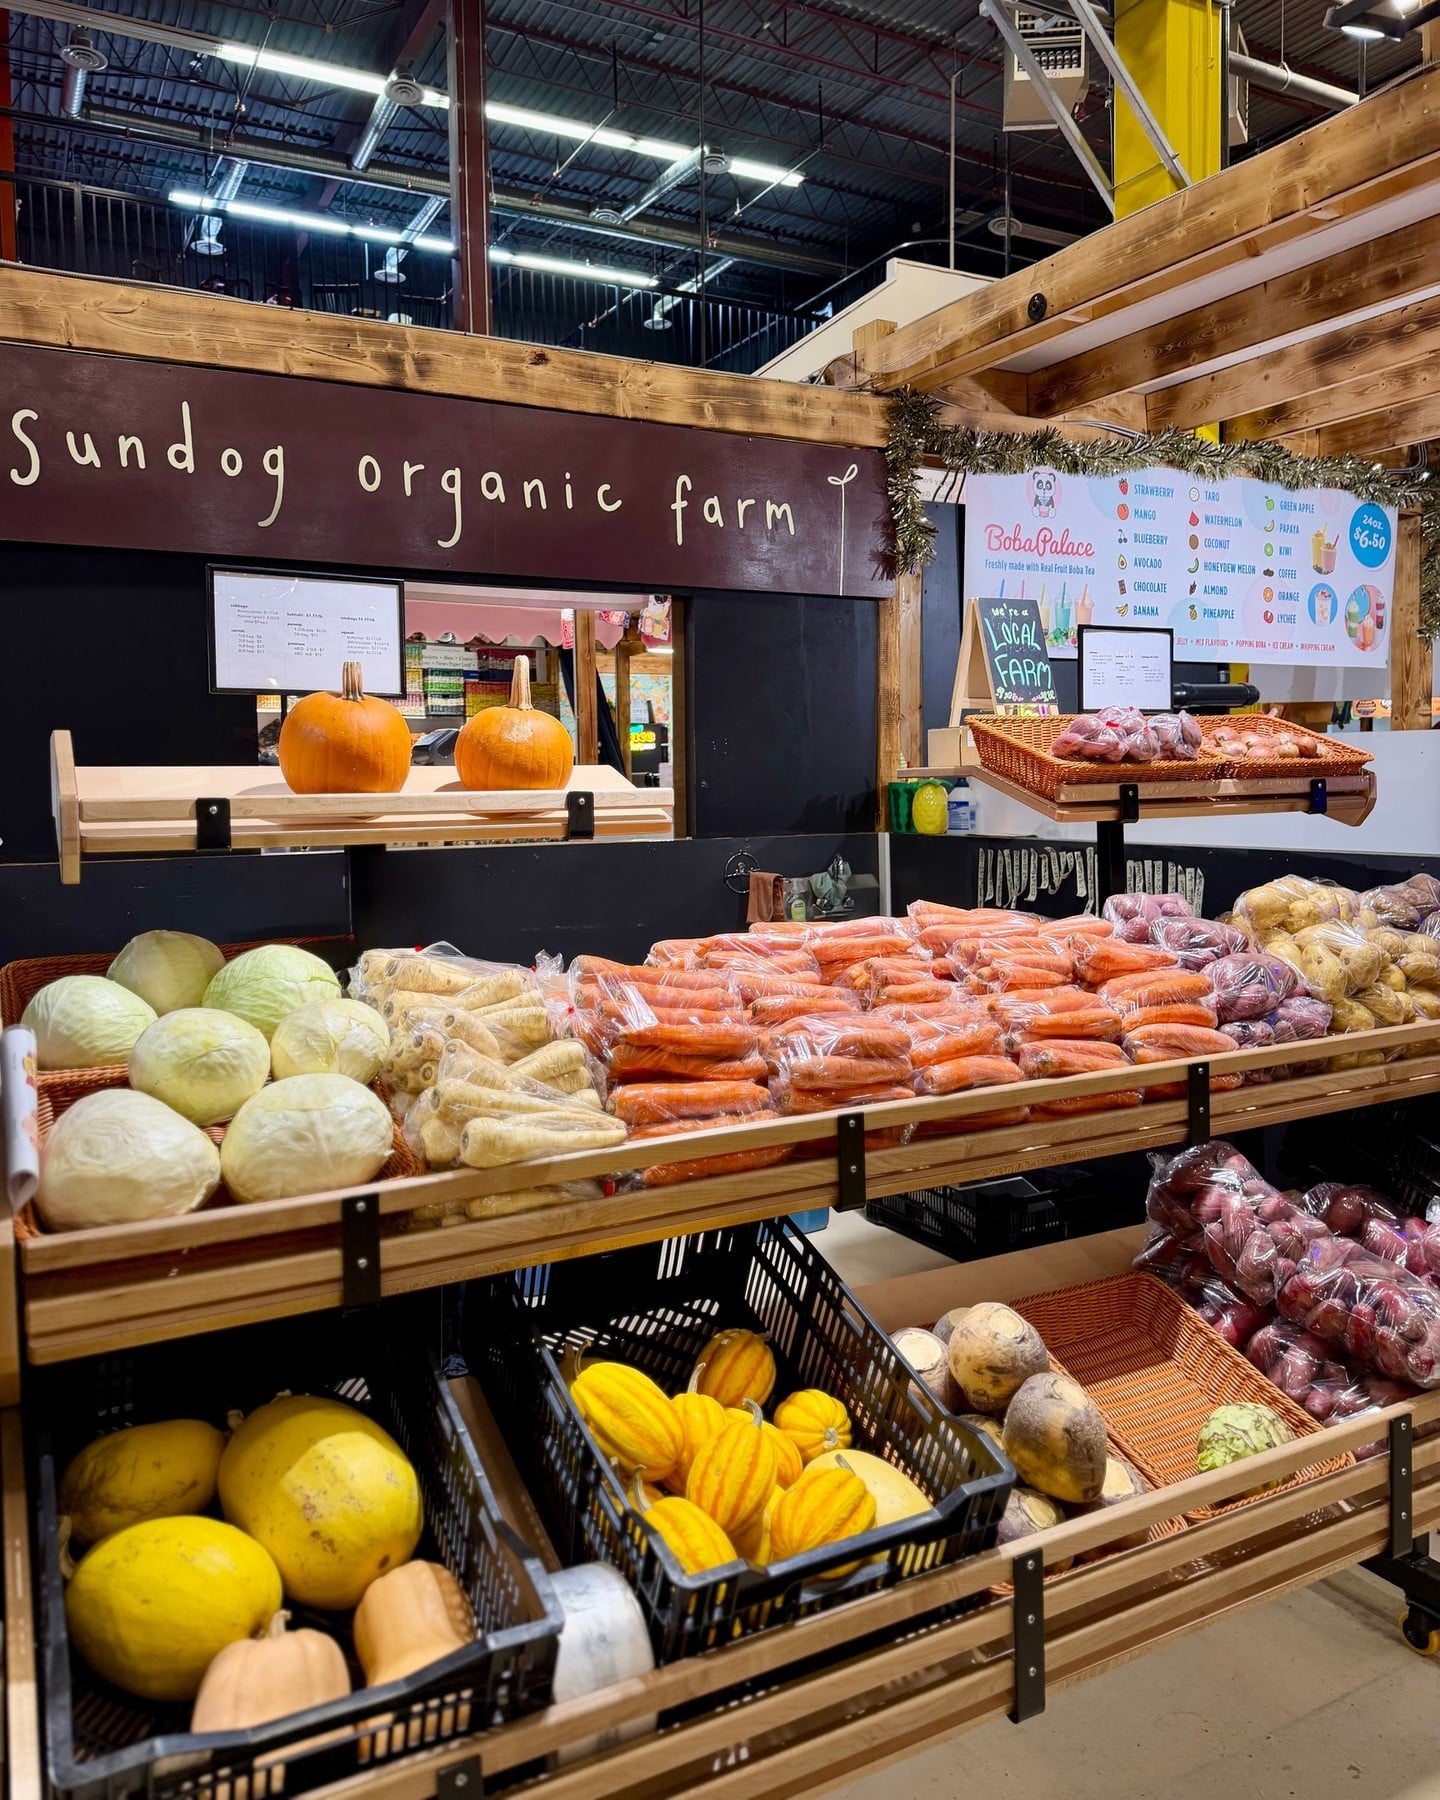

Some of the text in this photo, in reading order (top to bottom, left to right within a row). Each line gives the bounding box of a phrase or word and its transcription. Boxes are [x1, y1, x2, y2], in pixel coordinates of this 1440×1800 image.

[10, 401, 796, 548] Sundog organic farm
[1134, 484, 1174, 498] STRAWBERRY
[1205, 490, 1220, 502] TARO
[1280, 500, 1315, 514] GREEN APPLE
[1134, 508, 1157, 520] MANGO
[1204, 514, 1243, 528] WATERMELON
[1279, 523, 1300, 535] PAPAYA
[1133, 532, 1168, 546] BLUEBERRY
[1204, 537, 1230, 550] COCONUT
[1353, 526, 1386, 550] $6.50
[1279, 546, 1292, 557] KIWI
[985, 559, 1095, 576] Freshly made with Real Fruit Boba Tea
[1133, 557, 1162, 569] AVOCADO
[1203, 561, 1256, 575] HONEYDEW MELON
[1278, 568, 1297, 580] COFFEE
[1133, 581, 1167, 594] CHOCOLATE
[1203, 584, 1228, 596] ALMOND
[1278, 591, 1300, 602] ORANGE
[991, 603, 1019, 616] we're
[1133, 605, 1159, 617] BANANA
[1203, 607, 1235, 619] PINEAPPLE
[1277, 613, 1297, 624] LYCHEE
[984, 618, 1041, 651] LOCAL
[1176, 637, 1188, 646] JELLY
[1195, 638, 1205, 647] MIX
[1205, 638, 1229, 647] FLAVOURS
[1235, 639, 1255, 648] POPPING
[1279, 641, 1294, 650] CREAM
[1300, 643, 1320, 652] WHIPPING
[1320, 643, 1335, 652] CREAM
[994, 653, 1052, 689] FARM
